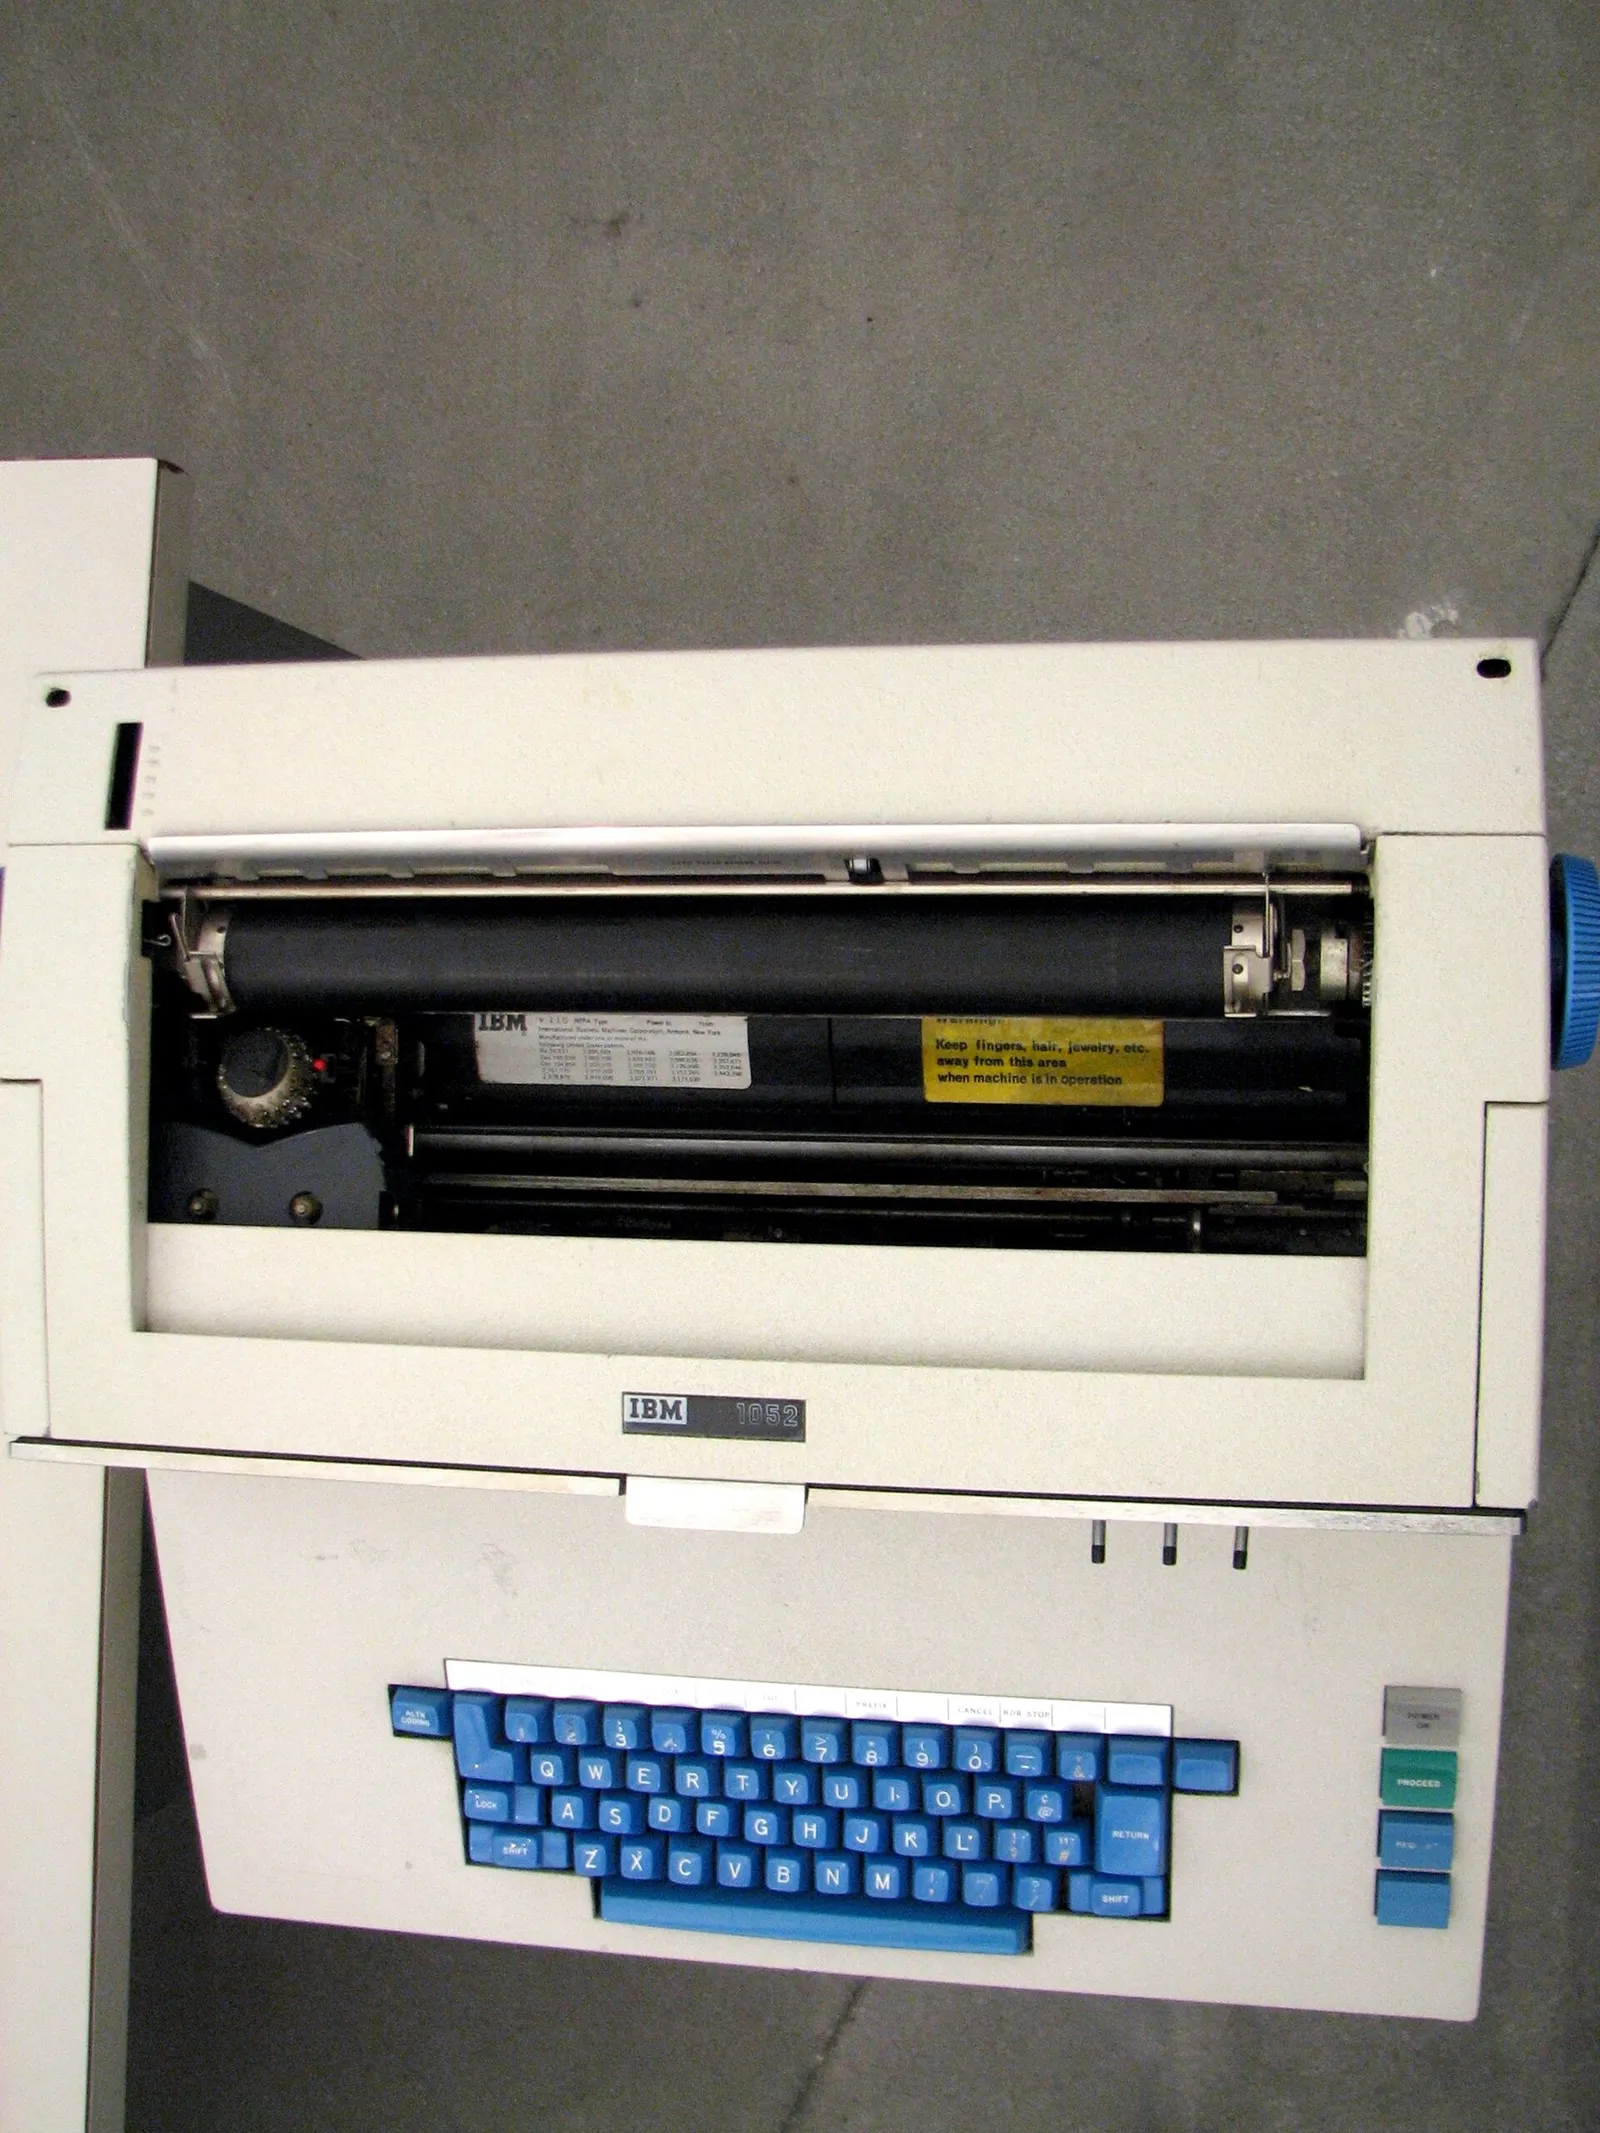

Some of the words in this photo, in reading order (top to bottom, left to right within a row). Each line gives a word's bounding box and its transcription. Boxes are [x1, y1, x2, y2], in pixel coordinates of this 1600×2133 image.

[478, 1013, 528, 1031] IBM
[936, 1039, 968, 1051] Keep
[976, 1040, 1027, 1053] fingers,
[1032, 1040, 1062, 1053] hair,
[1124, 1043, 1149, 1054] etc.
[937, 1058, 969, 1068] away
[974, 1056, 1004, 1067] from
[1009, 1057, 1033, 1068] this
[1038, 1060, 1067, 1068] area
[938, 1072, 970, 1084] when
[973, 1073, 1027, 1085] machine
[1031, 1074, 1043, 1084] is
[1045, 1074, 1058, 1085] in
[1061, 1074, 1122, 1086] operation
[630, 1398, 682, 1420] IBM
[737, 1402, 799, 1427] 1052
[958, 1706, 993, 1716] CANCEL
[1027, 1710, 1050, 1719] STOP
[615, 1733, 627, 1746] 3
[713, 1740, 726, 1755] 5
[763, 1743, 776, 1757] 6
[815, 1746, 828, 1761] 7
[865, 1750, 878, 1765] 8
[916, 1752, 930, 1766] 9
[539, 1761, 555, 1779] Q
[587, 1765, 604, 1780] W
[637, 1768, 651, 1784] E
[686, 1772, 700, 1789] R
[736, 1774, 749, 1791] T
[785, 1779, 799, 1796] Y
[1397, 1778, 1441, 1789] PROCEED
[834, 1784, 849, 1800] U
[935, 1790, 952, 1807] O
[475, 1800, 498, 1810] LOCK
[987, 1793, 1002, 1809] P
[561, 1802, 575, 1820] A
[609, 1808, 622, 1825] S
[658, 1805, 672, 1822] D
[706, 1810, 720, 1827] F
[1038, 1806, 1054, 1818] @
[754, 1818, 769, 1836] G
[803, 1822, 817, 1839] H
[855, 1827, 869, 1843] J
[1112, 1829, 1150, 1841] RETURN
[904, 1832, 918, 1849] K
[956, 1834, 969, 1851] L
[503, 1844, 529, 1856] SHIFT
[584, 1849, 599, 1869] Z
[631, 1853, 644, 1871] X
[678, 1858, 692, 1876] C
[729, 1862, 742, 1880] V
[776, 1866, 791, 1884] B
[826, 1868, 840, 1886] N
[875, 1873, 890, 1890] M
[1102, 1894, 1130, 1904] SHIFT
